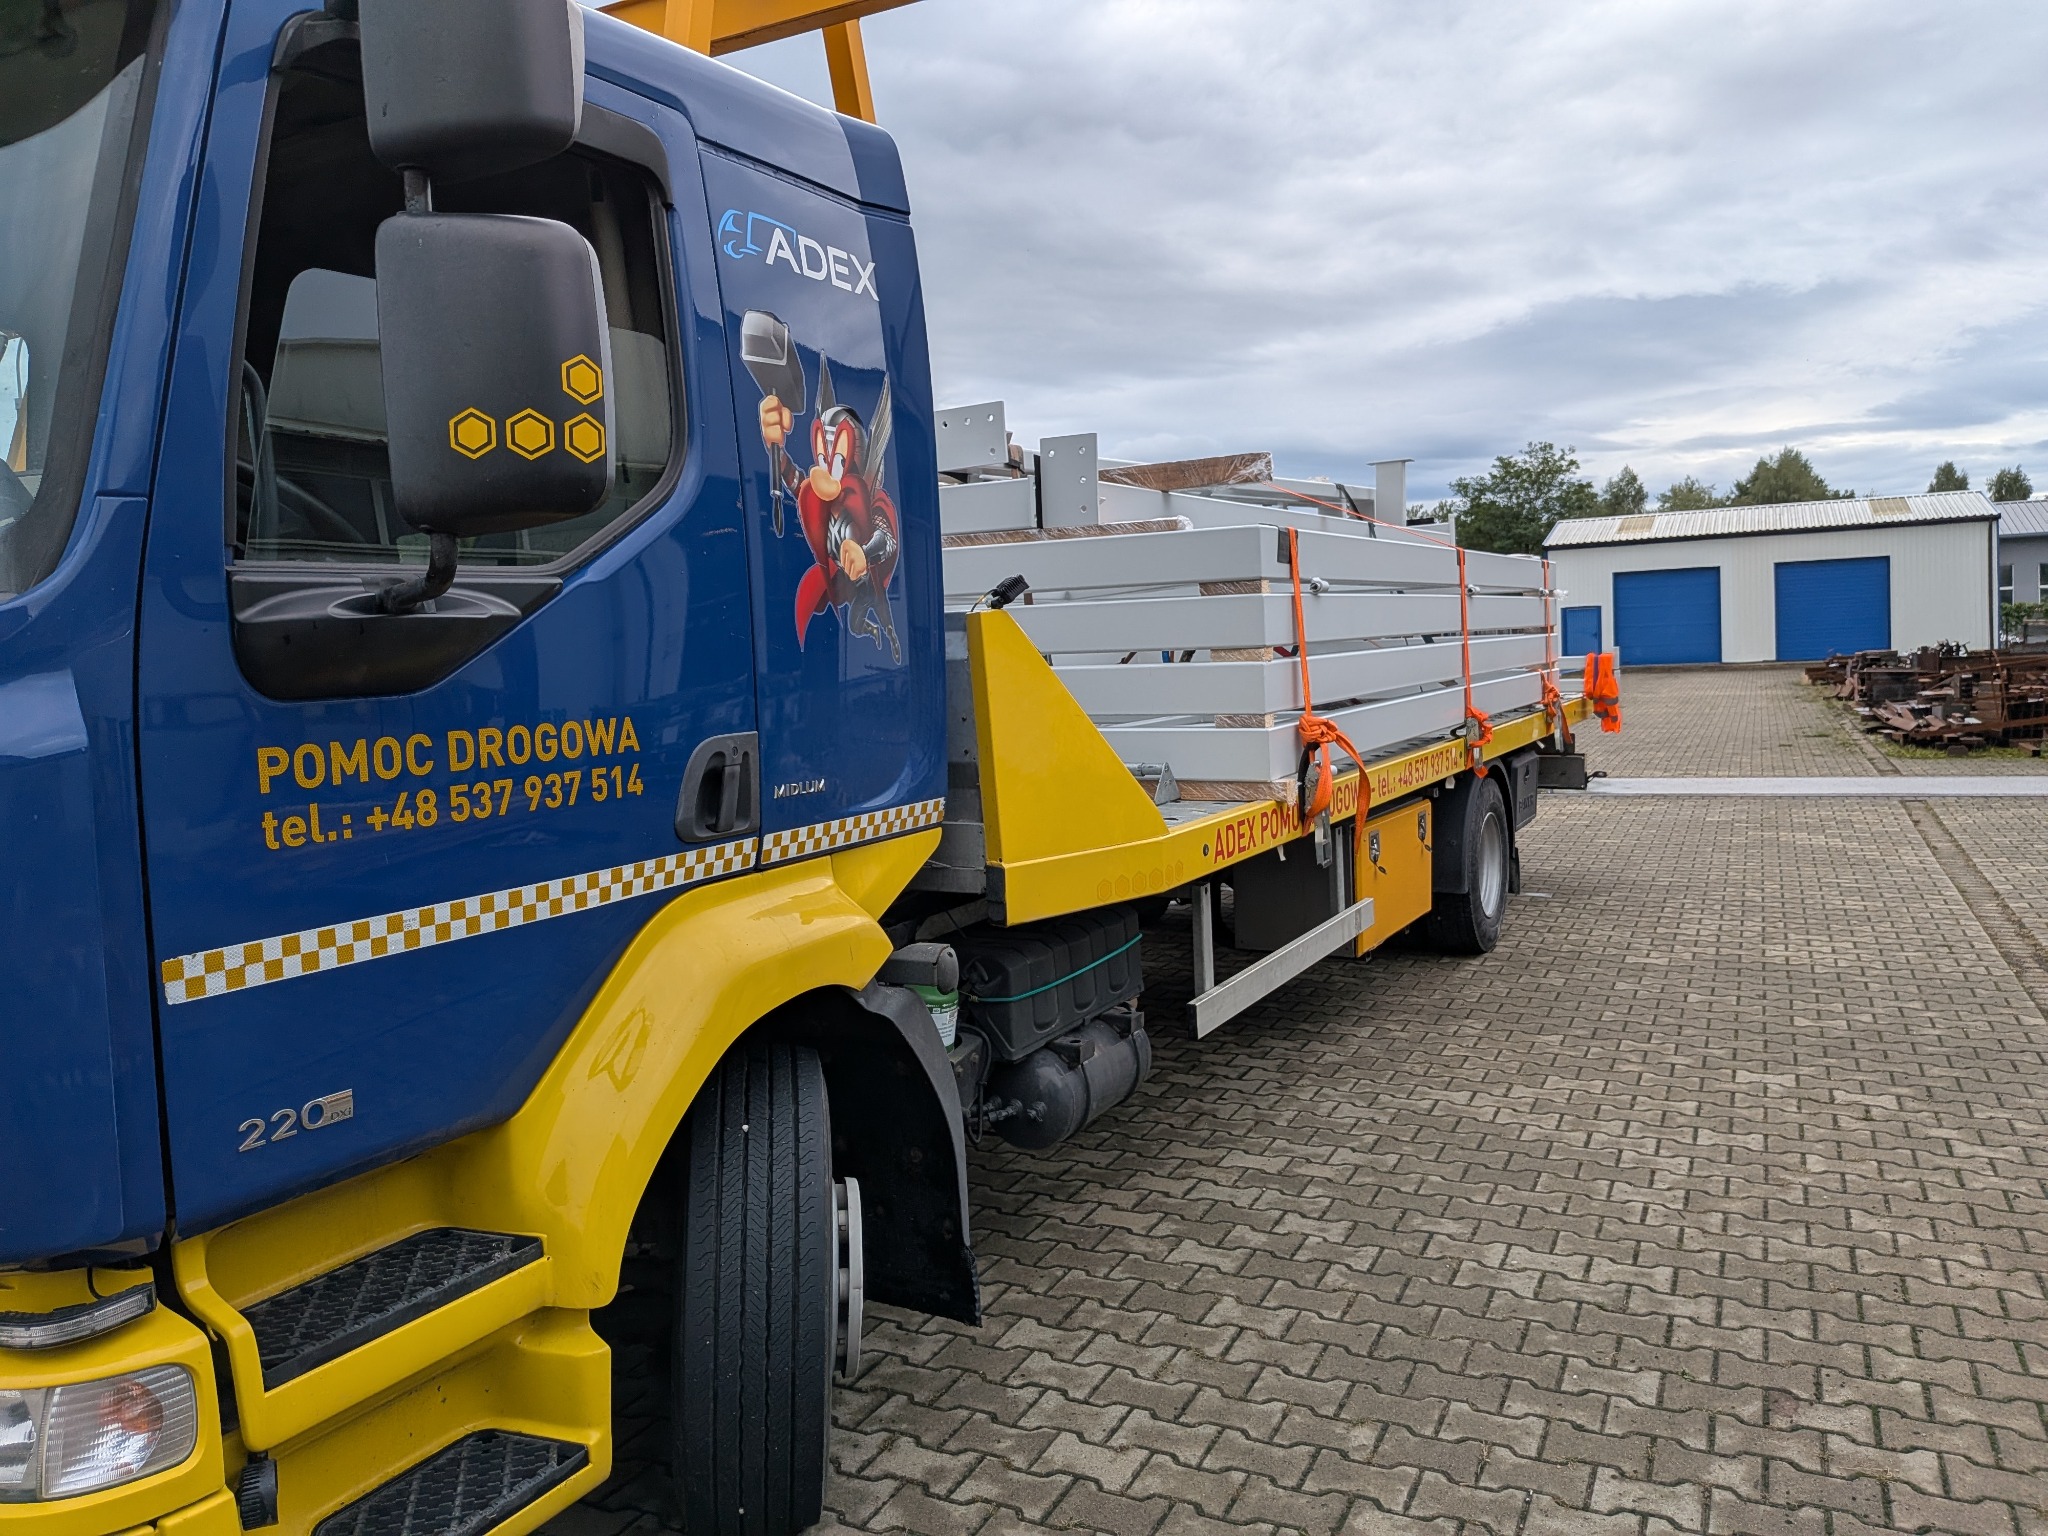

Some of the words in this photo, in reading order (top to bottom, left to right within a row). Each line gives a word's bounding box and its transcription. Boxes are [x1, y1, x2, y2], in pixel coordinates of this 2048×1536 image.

[765, 227, 880, 302] ADEX
[256, 733, 435, 794] POMOC
[447, 716, 641, 773] DROGOWA
[773, 778, 826, 799] MIDLUM
[261, 802, 354, 850] tel.:
[366, 789, 438, 832] +48
[449, 777, 514, 823] 537
[523, 769, 583, 812] 937
[591, 762, 645, 802] 514
[1213, 815, 1257, 865] ADEX
[1260, 801, 1300, 845] POMO
[1377, 769, 1396, 798] tel.:
[1398, 762, 1413, 788] +48
[1414, 755, 1429, 784] 537
[1430, 750, 1444, 777] 937
[238, 1098, 326, 1153] 220
